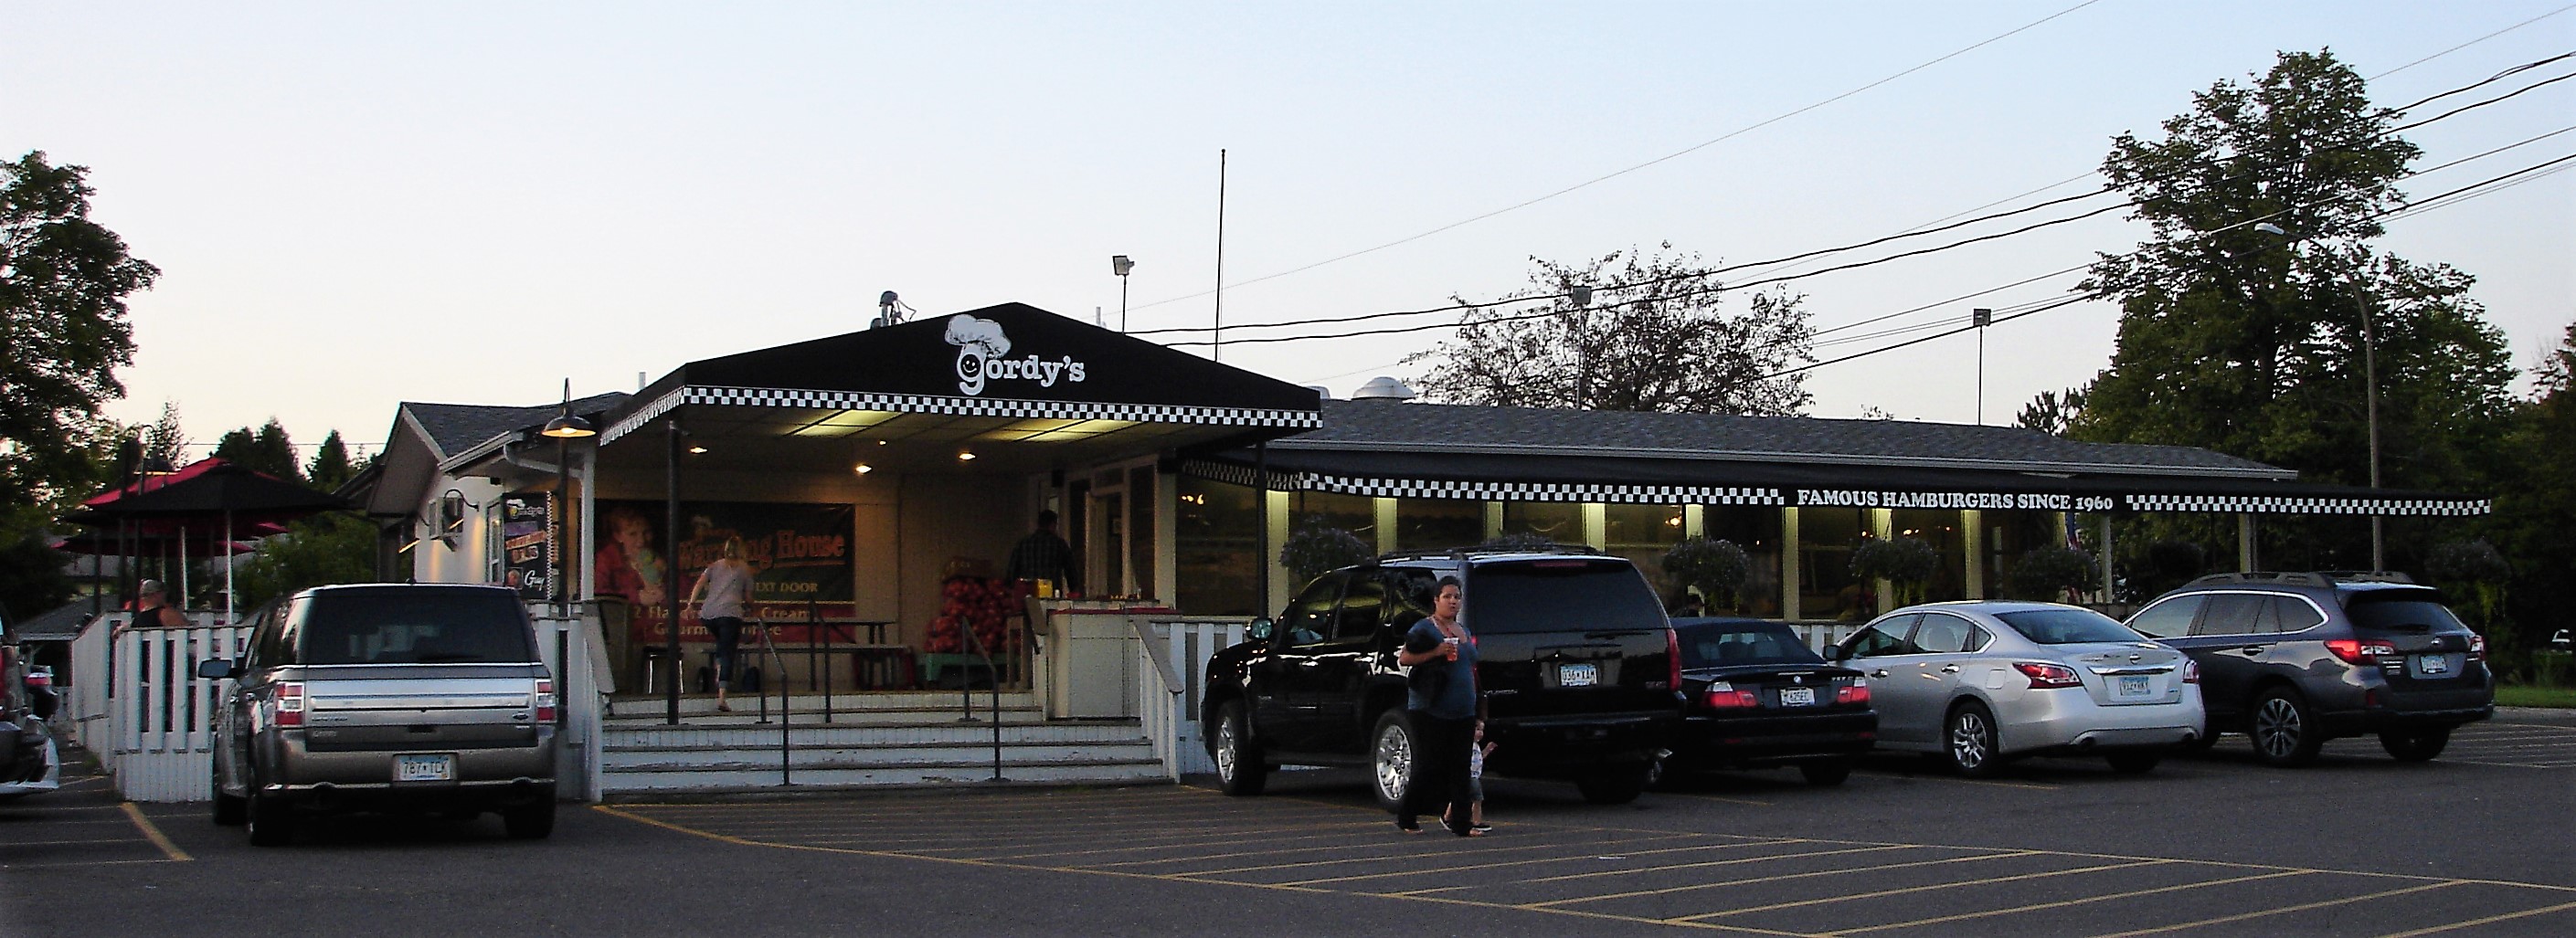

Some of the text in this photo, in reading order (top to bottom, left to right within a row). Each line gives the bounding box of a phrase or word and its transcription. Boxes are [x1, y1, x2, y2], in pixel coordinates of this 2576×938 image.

[957, 349, 1087, 395] gordy's
[1797, 490, 2114, 511] FAMOUS HAMBURGERS SINCE 1960
[776, 530, 846, 559] House
[779, 582, 819, 593] DOOR
